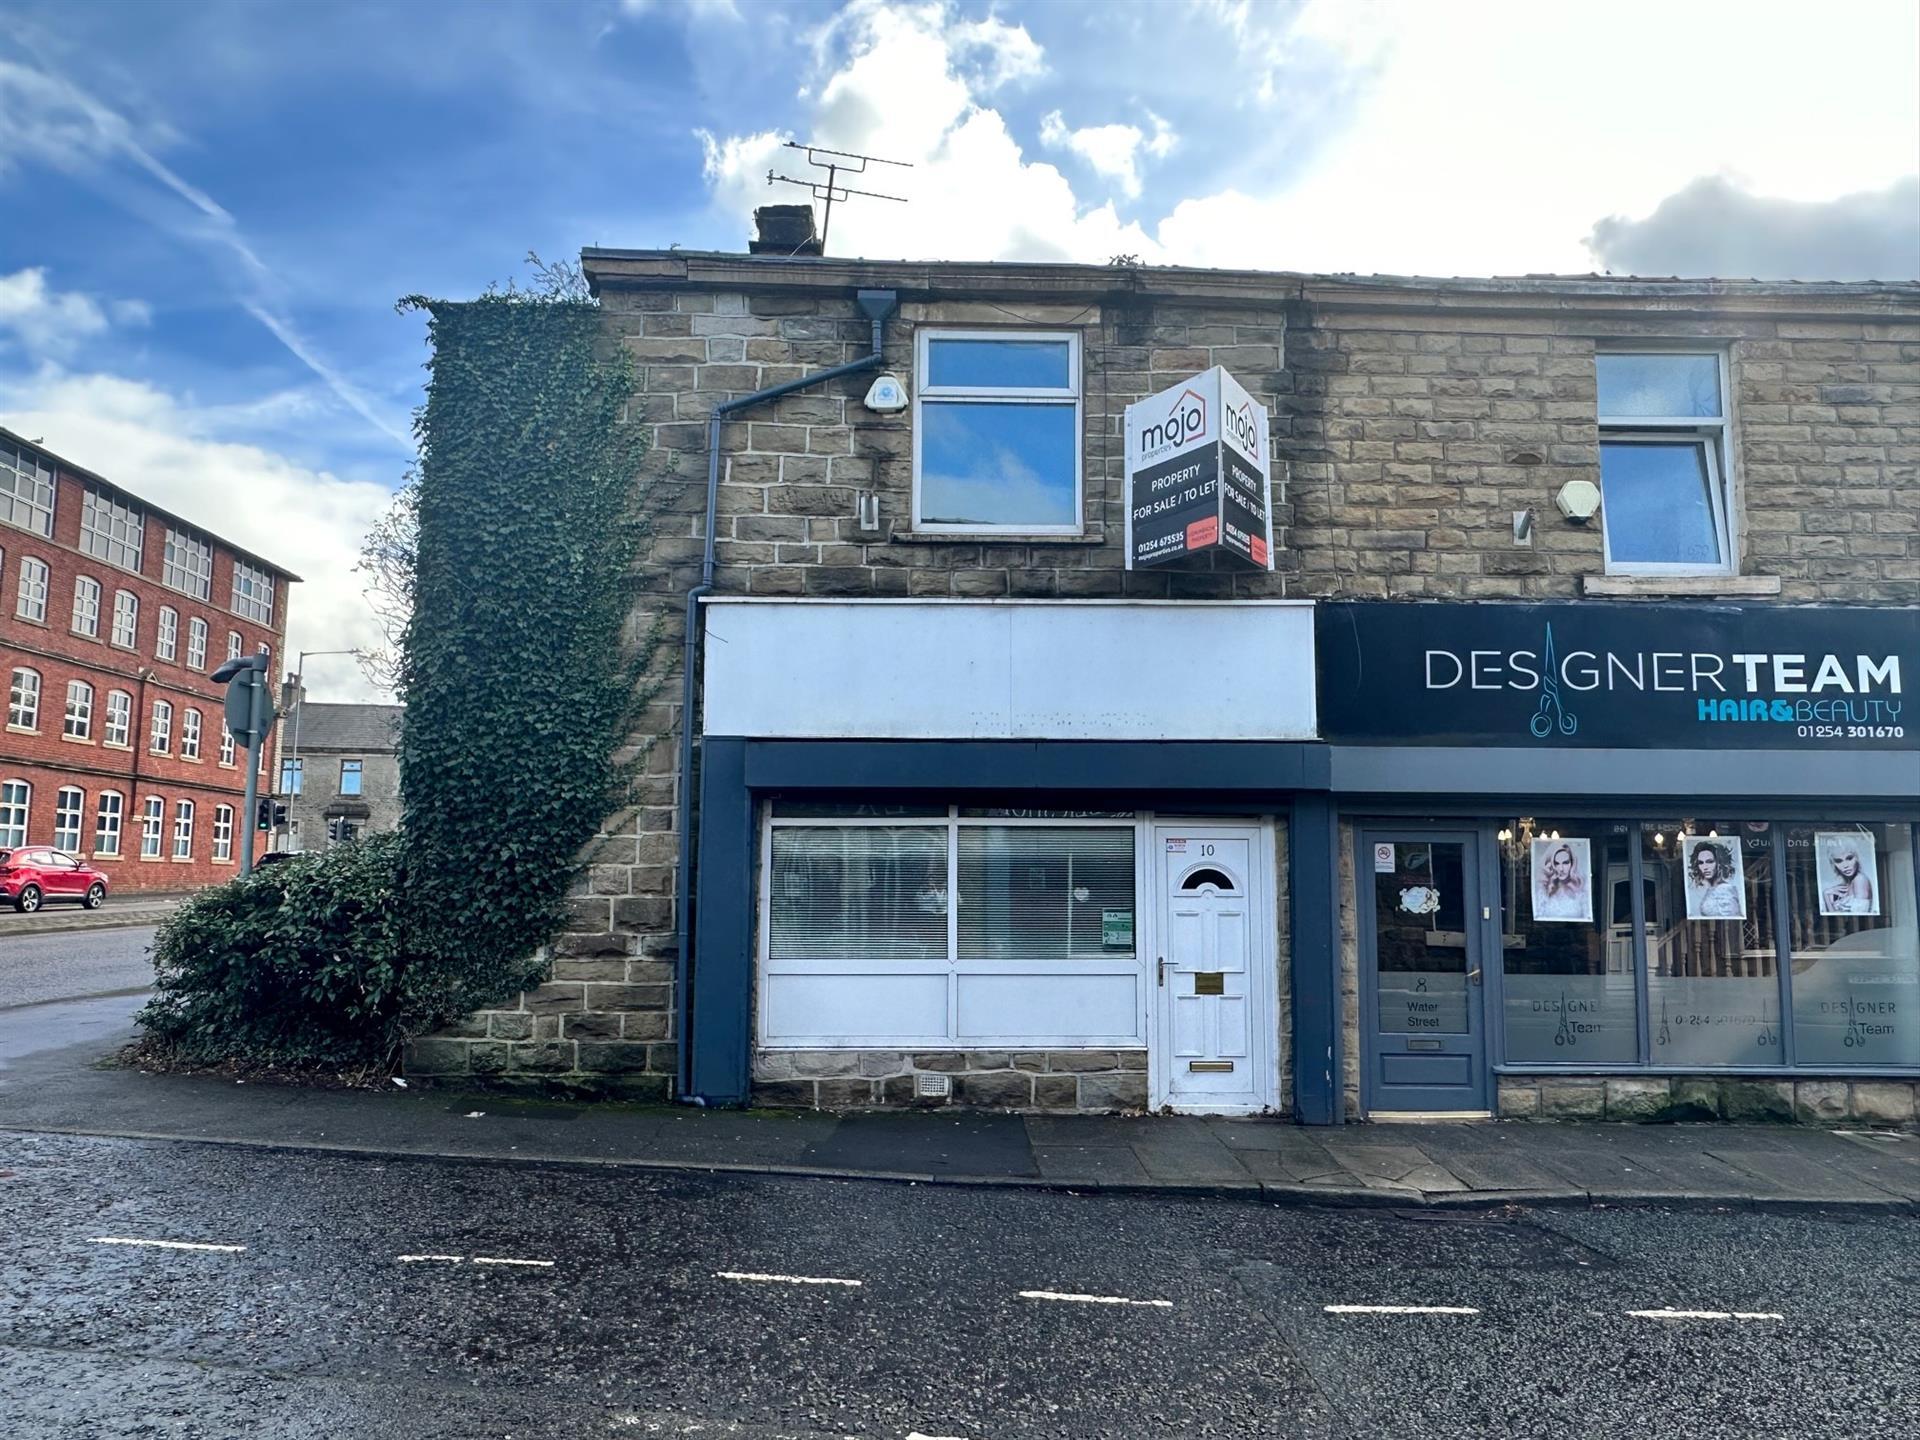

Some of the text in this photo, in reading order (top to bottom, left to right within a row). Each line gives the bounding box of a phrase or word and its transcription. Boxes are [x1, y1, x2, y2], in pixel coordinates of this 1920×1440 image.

[1142, 406, 1201, 452] mojo
[1226, 403, 1256, 452] mojo
[1151, 464, 1201, 492] PROPERTY
[1232, 465, 1257, 492] PROPERTY
[1133, 504, 1152, 521] FOR
[1154, 494, 1176, 513] SALE
[1184, 487, 1197, 502] TO
[1199, 480, 1216, 496] LET
[1225, 482, 1235, 499] FOR
[1235, 490, 1247, 510] SALE
[1249, 502, 1257, 516] TO
[1257, 507, 1266, 522] LET
[1138, 539, 1158, 553] 01254
[1425, 650, 1902, 694] DESIGNER TEAM
[1797, 725, 1904, 739] 01254 301670
[1201, 844, 1215, 856] 10
[1415, 977, 1427, 993] 8
[1407, 1002, 1438, 1012] Water
[1532, 1000, 1602, 1012] DESIGNE
[1820, 1001, 1896, 1014] DESIGNER
[1407, 1016, 1440, 1027] Street
[1675, 1015, 1710, 1025] 0254
[1859, 1022, 1895, 1034] Team
